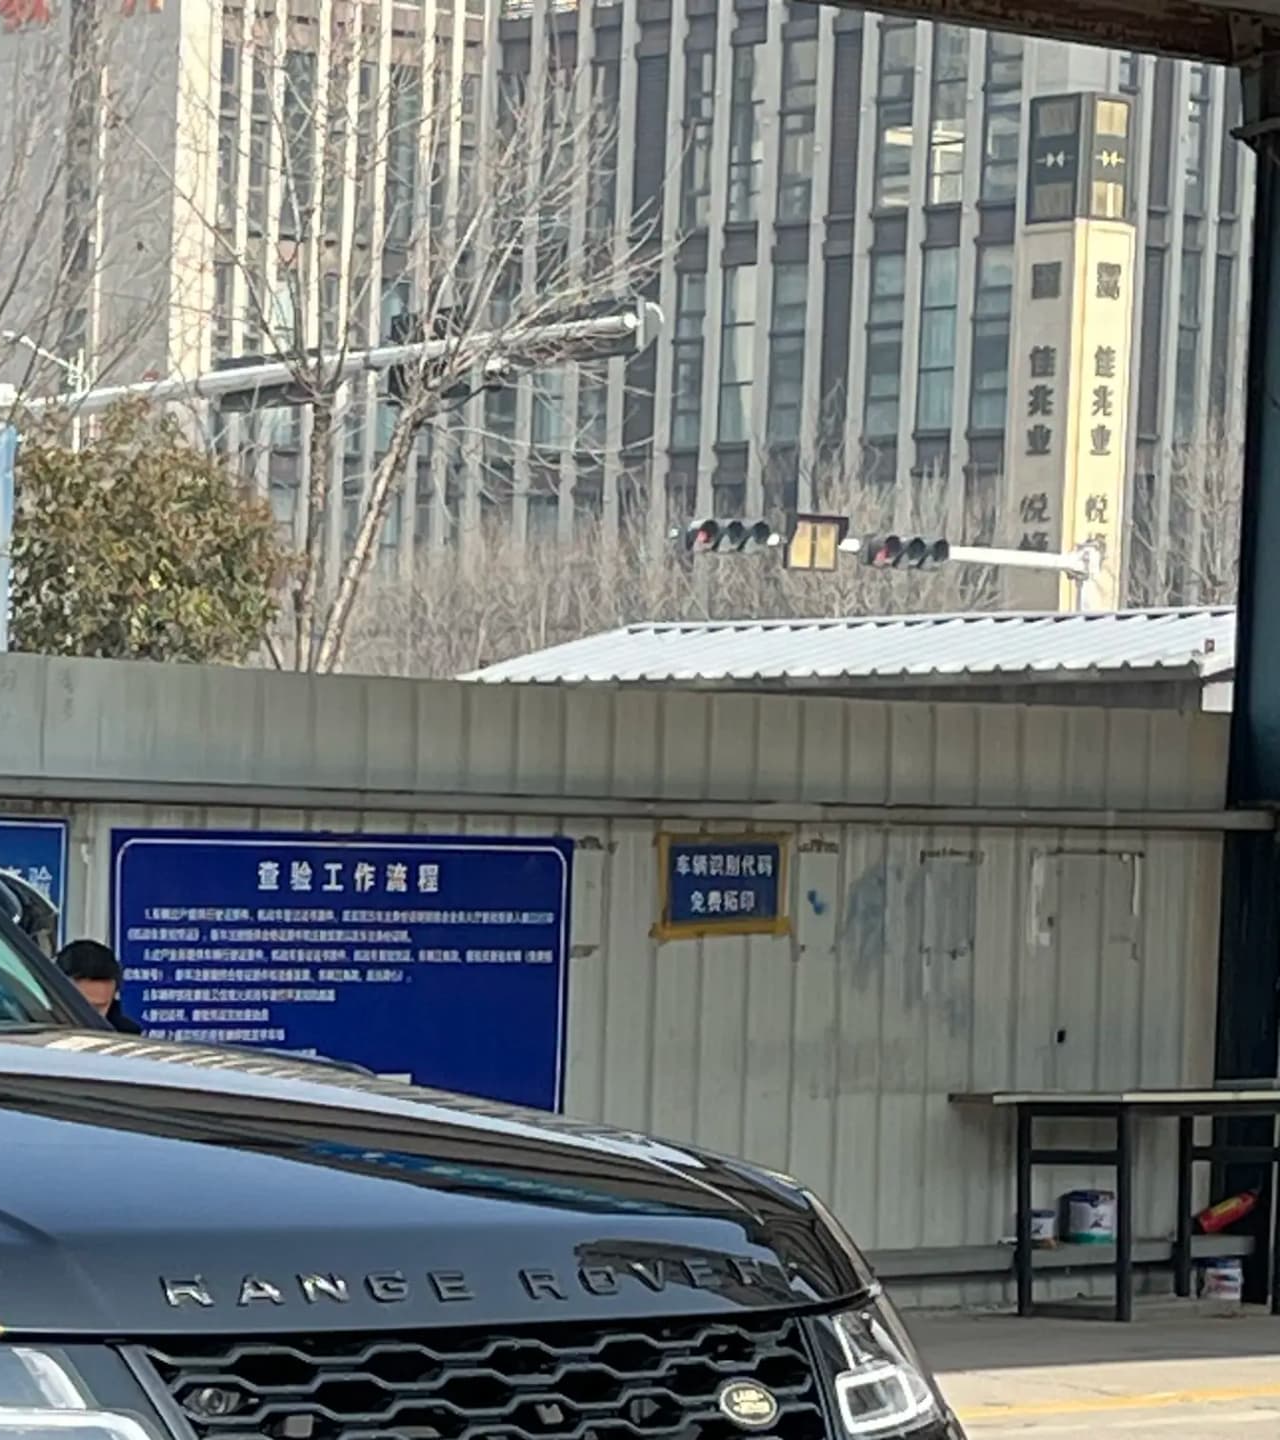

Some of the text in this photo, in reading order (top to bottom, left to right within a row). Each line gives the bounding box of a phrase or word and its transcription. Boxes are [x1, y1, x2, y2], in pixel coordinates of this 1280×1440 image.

[257, 860, 441, 893] 查验工作流程
[676, 854, 773, 877] 车辆识别代码
[690, 889, 755, 913] 免费拓印
[160, 1257, 770, 1307] RANGE ROVER
